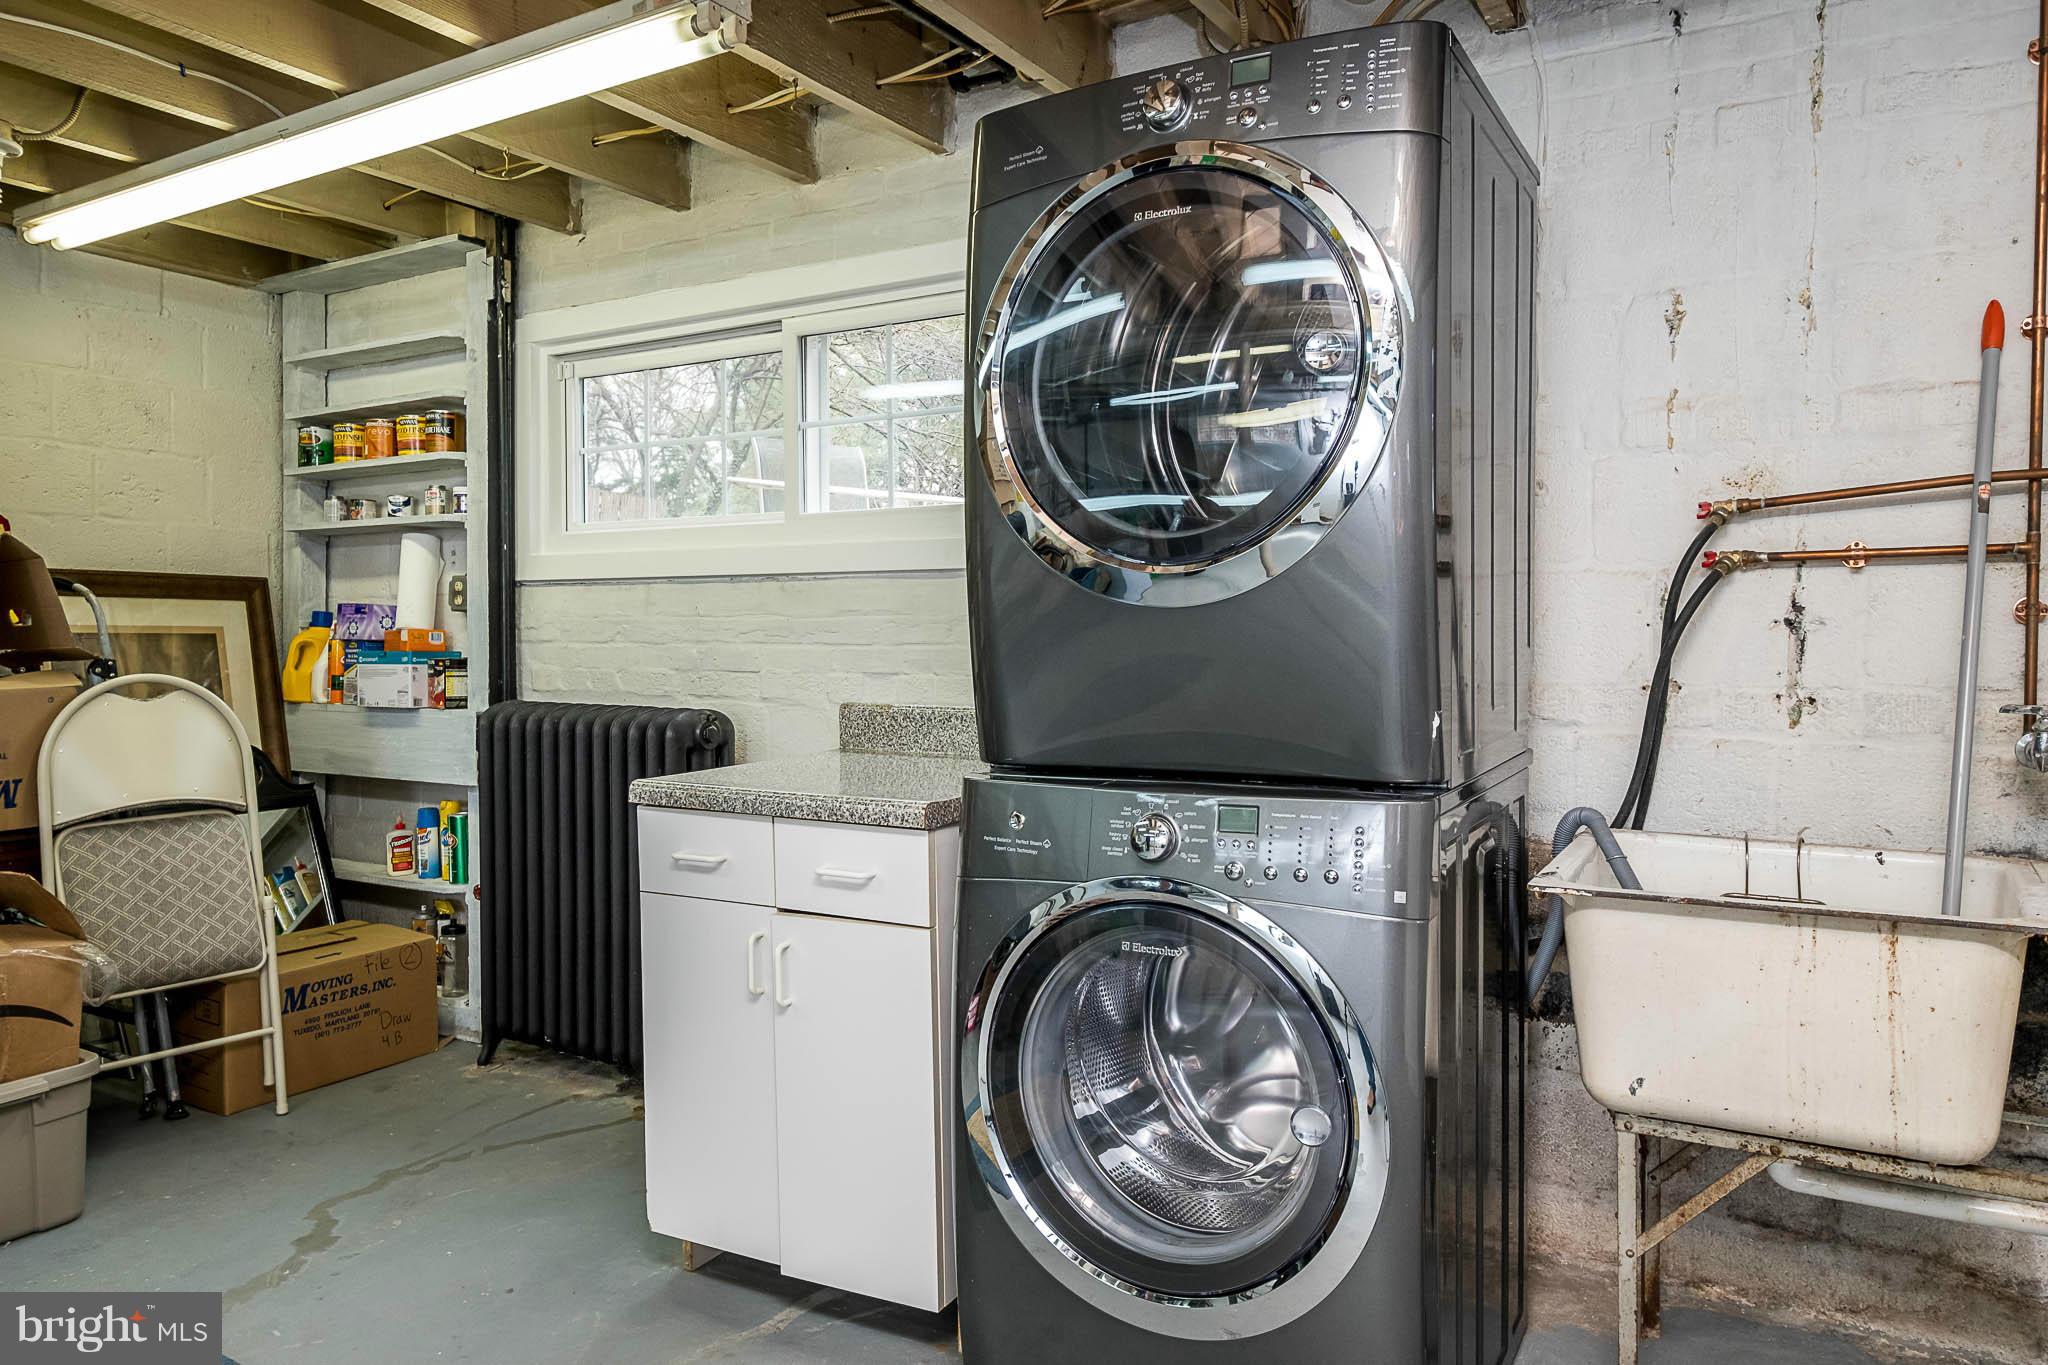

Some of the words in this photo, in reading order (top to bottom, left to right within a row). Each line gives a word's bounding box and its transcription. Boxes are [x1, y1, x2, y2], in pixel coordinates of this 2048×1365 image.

[1145, 205, 1192, 220] Electrolux
[366, 427, 391, 436] revo
[1132, 942, 1183, 957] Electrolux
[381, 1010, 412, 1030] Draw
